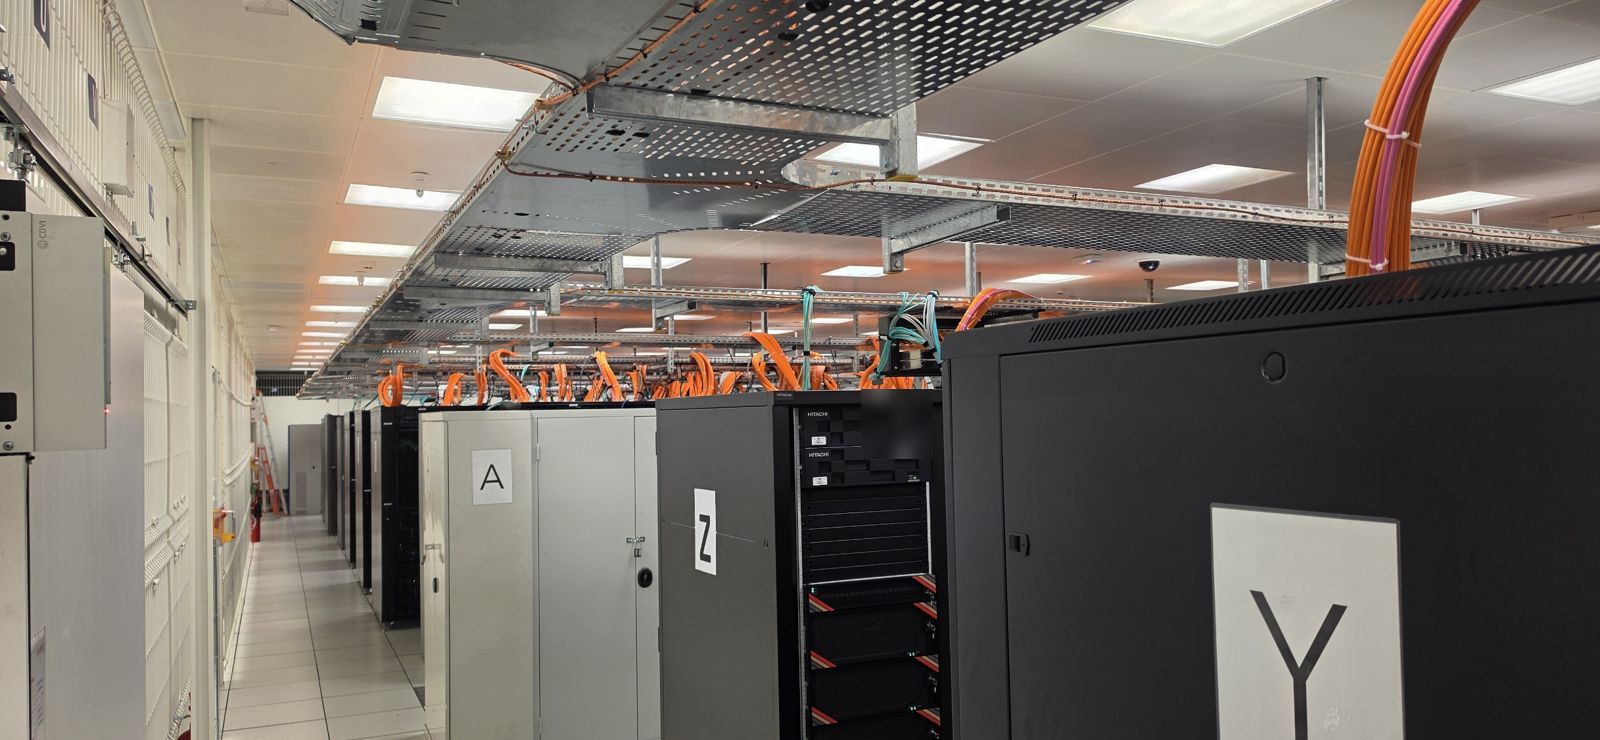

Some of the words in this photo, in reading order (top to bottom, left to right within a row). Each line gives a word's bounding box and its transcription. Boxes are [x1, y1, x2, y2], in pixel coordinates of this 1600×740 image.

[39, 220, 47, 239] CDVI
[479, 464, 504, 491] A
[699, 513, 711, 563] Z
[1250, 589, 1348, 740] Y
